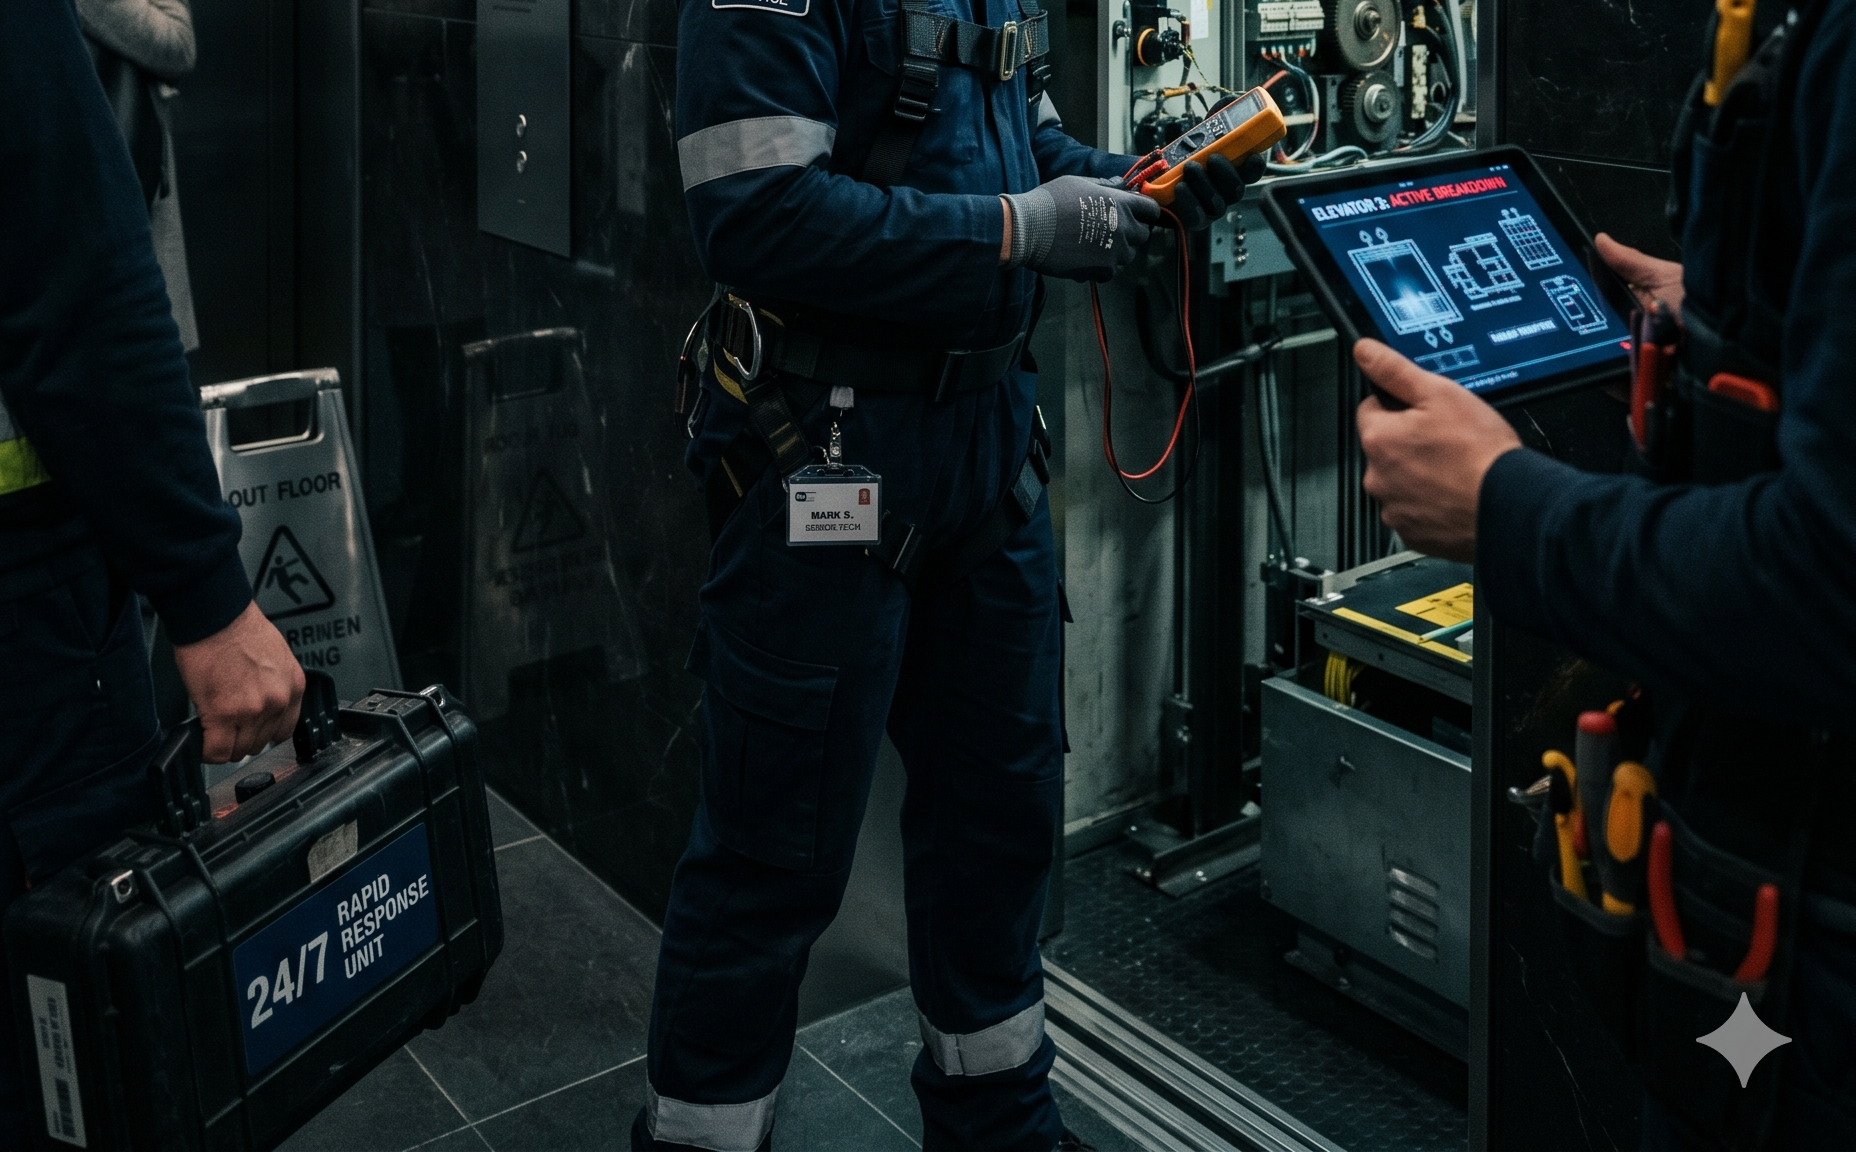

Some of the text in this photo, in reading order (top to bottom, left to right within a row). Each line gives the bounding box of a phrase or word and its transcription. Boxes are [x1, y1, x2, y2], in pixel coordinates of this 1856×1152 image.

[1311, 198, 1377, 222] ELEVATOR
[1389, 188, 1434, 207] ACTIVE
[1434, 176, 1507, 199] BREAKDOWN
[228, 471, 341, 508] OUT FLOOR
[811, 510, 854, 519] MARK S.
[337, 873, 390, 926] RAPID
[341, 874, 429, 953] RESPONSE
[345, 933, 384, 979] UNIT
[247, 931, 328, 1029] 24/7
